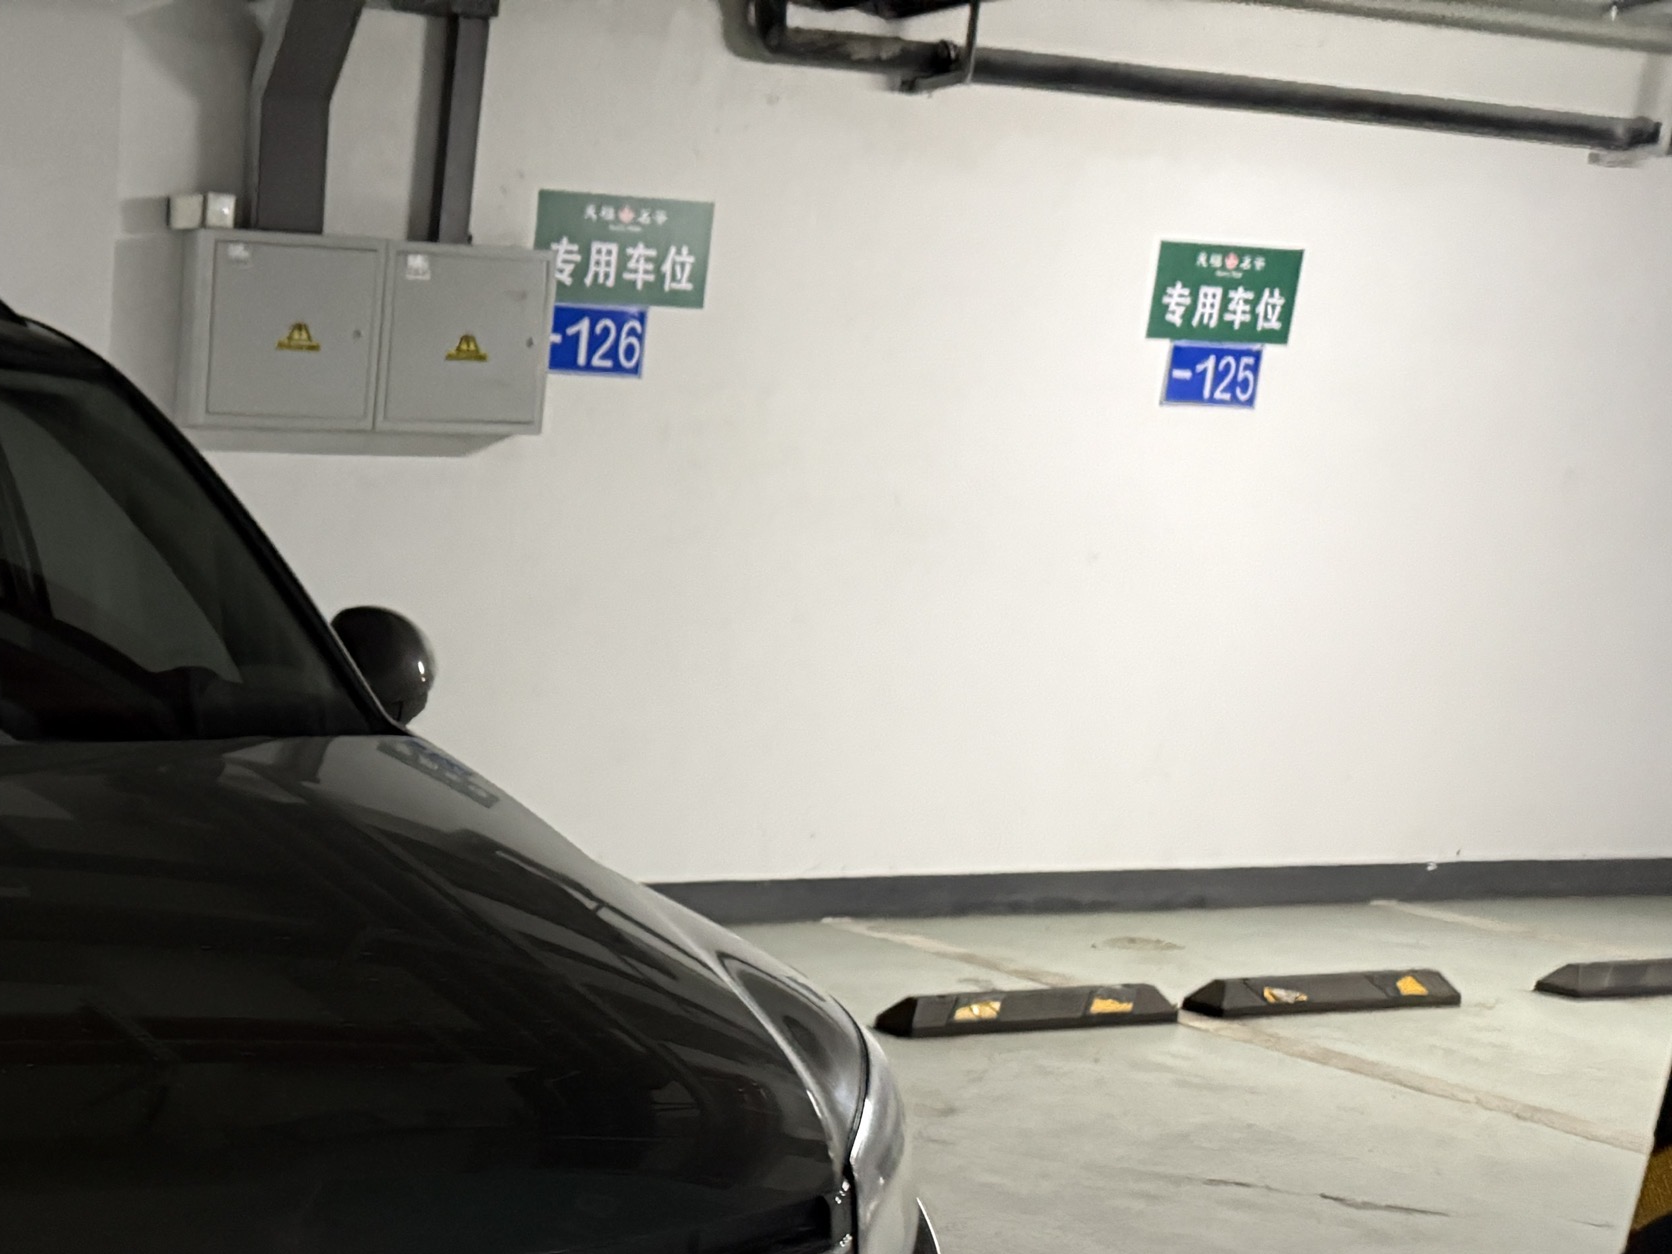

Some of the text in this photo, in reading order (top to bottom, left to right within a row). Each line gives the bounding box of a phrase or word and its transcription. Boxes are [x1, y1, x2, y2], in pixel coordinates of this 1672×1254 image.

[550, 235, 696, 292] 专用车位
[1161, 280, 1285, 331] 专用车位
[549, 316, 643, 369] -126
[1171, 354, 1257, 403] -125
